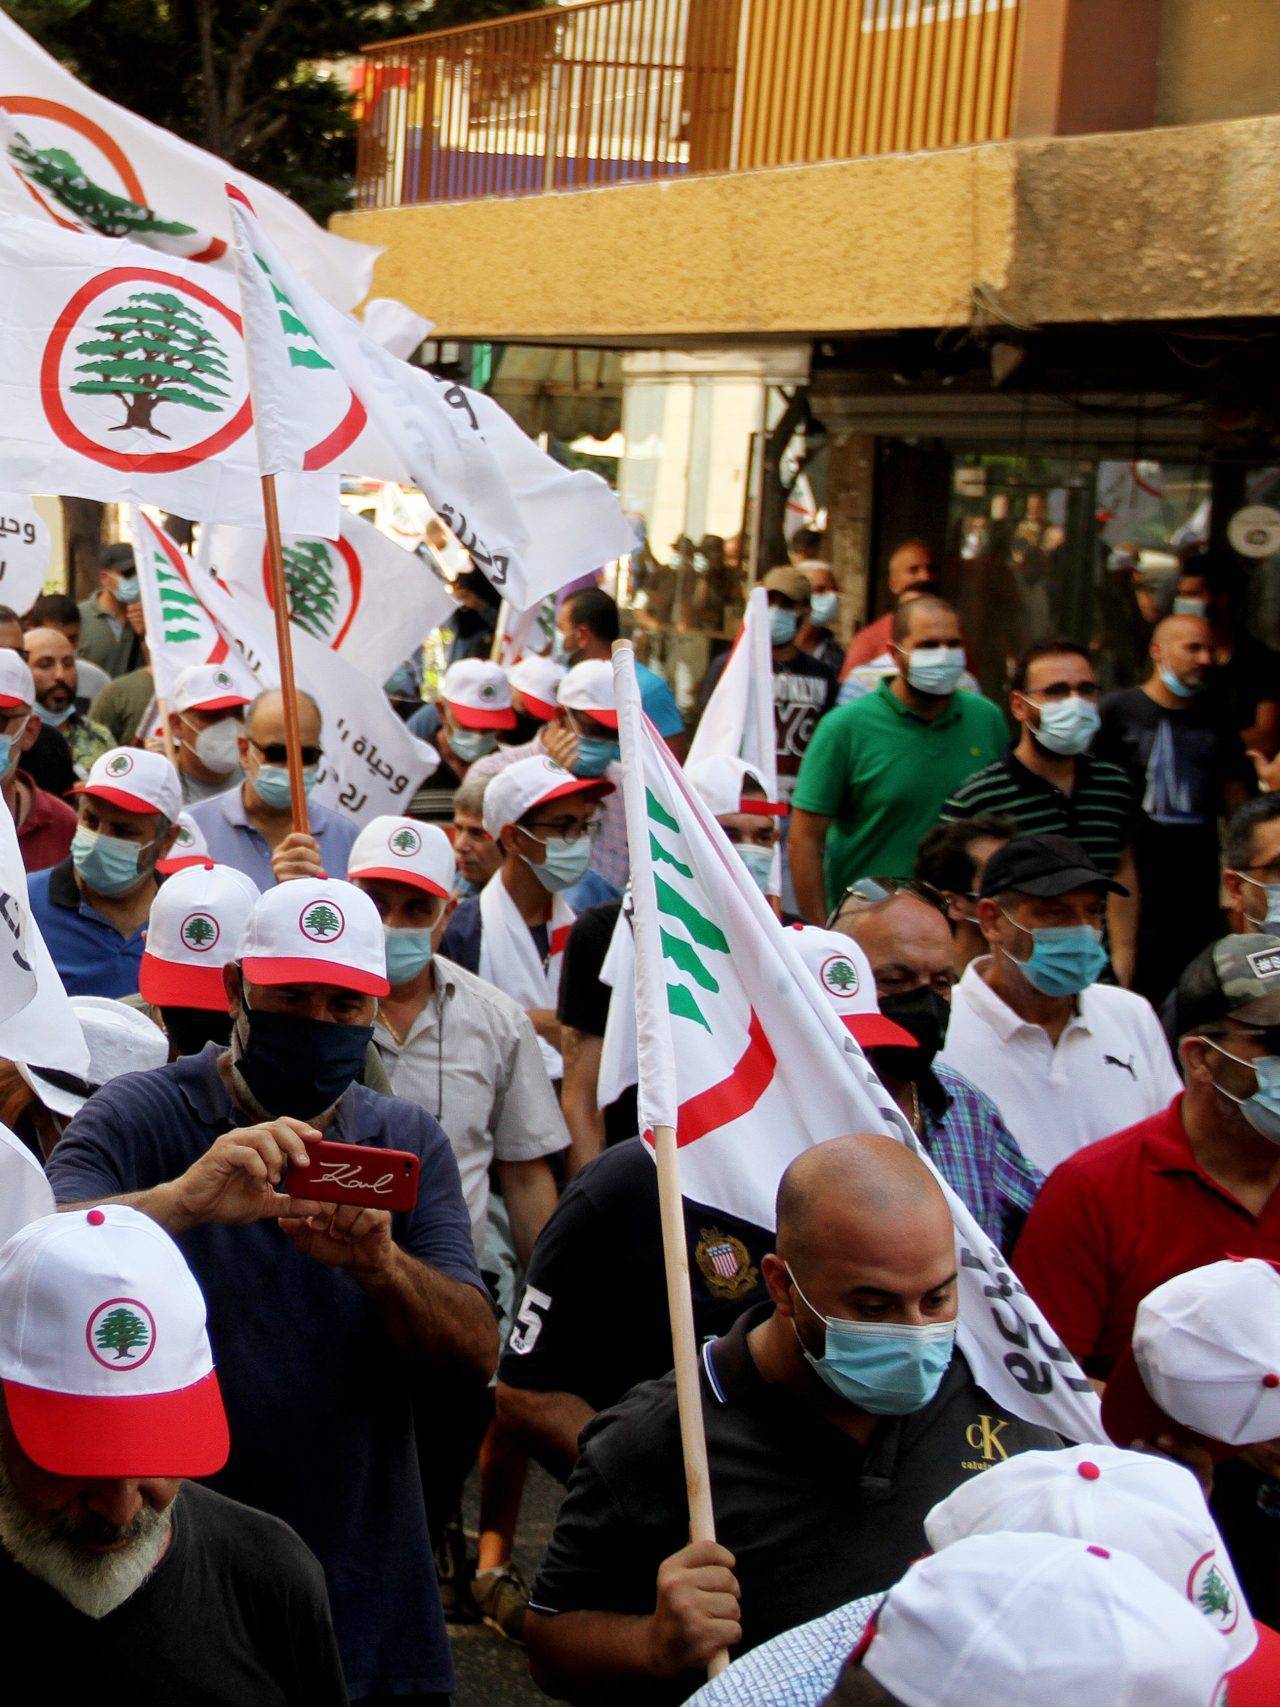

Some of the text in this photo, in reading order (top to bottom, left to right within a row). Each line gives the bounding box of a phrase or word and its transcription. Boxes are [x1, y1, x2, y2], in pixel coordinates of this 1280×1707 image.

[351, 735, 411, 796] وحياة
[338, 782, 368, 813] رح
[508, 1283, 553, 1356] 5
